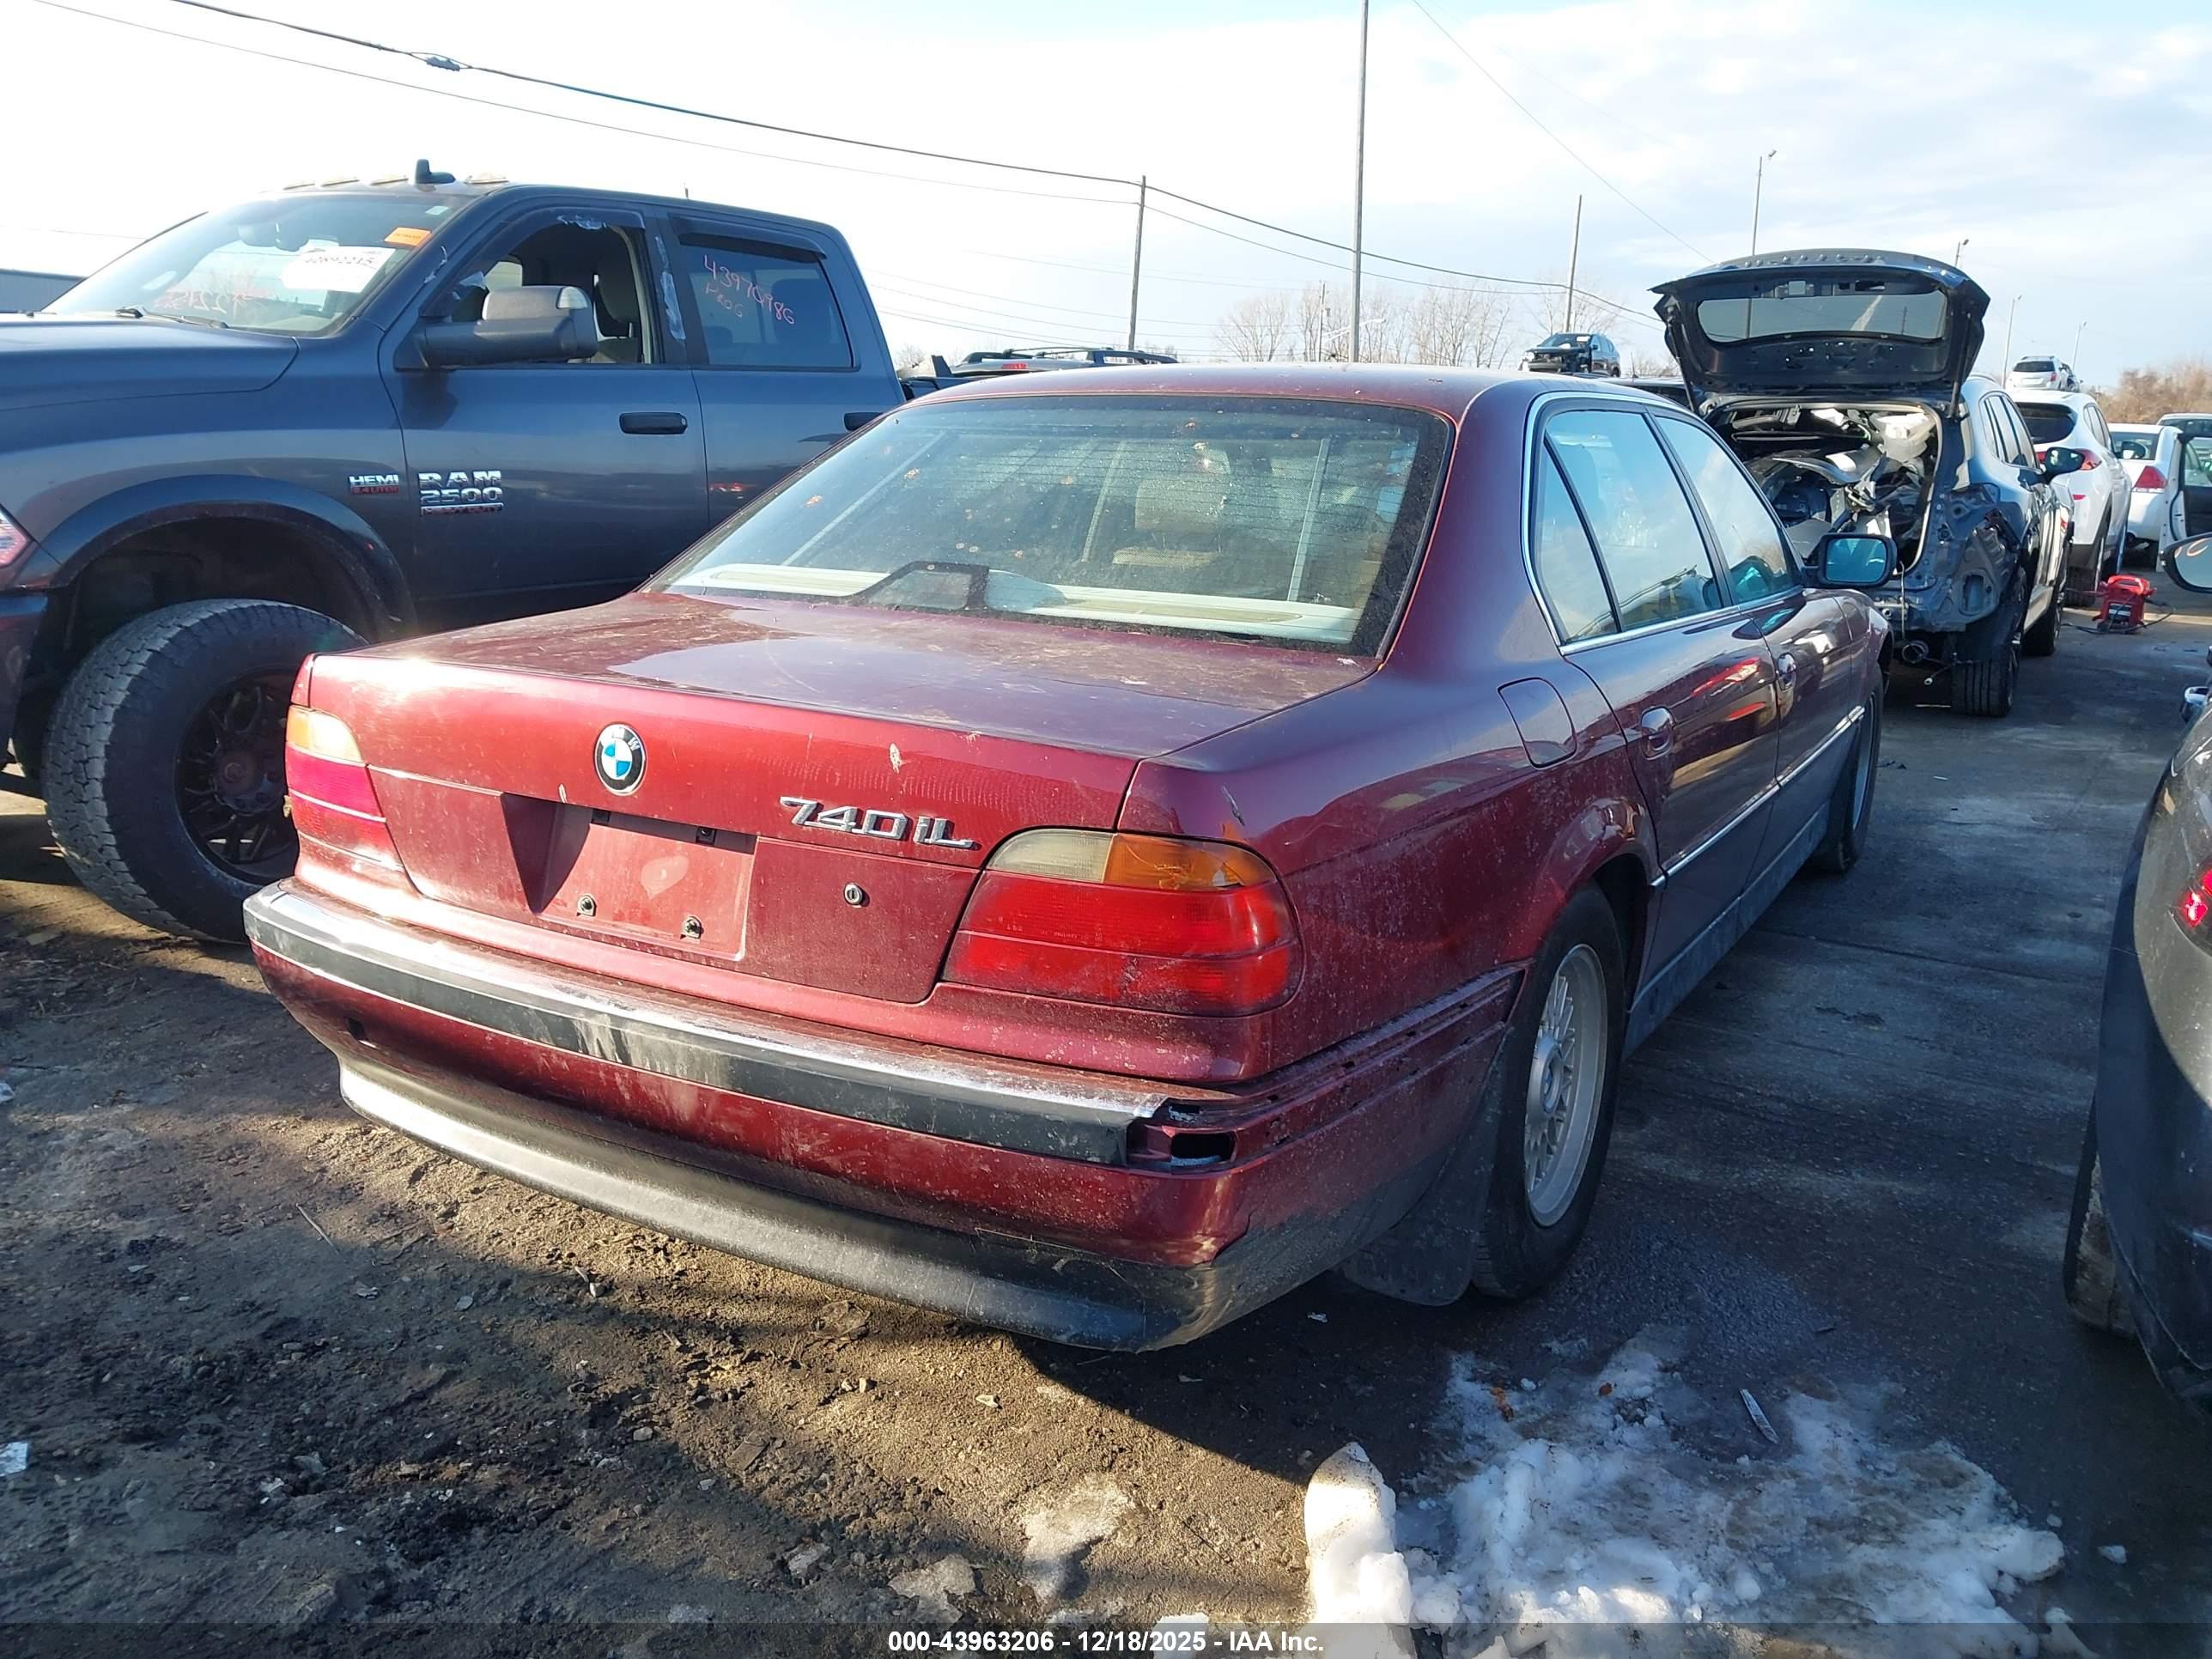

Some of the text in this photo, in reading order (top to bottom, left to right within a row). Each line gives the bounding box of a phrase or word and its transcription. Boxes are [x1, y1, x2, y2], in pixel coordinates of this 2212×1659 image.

[349, 474, 400, 488] HEMI
[417, 470, 503, 489] RAM
[419, 487, 504, 504] 2500
